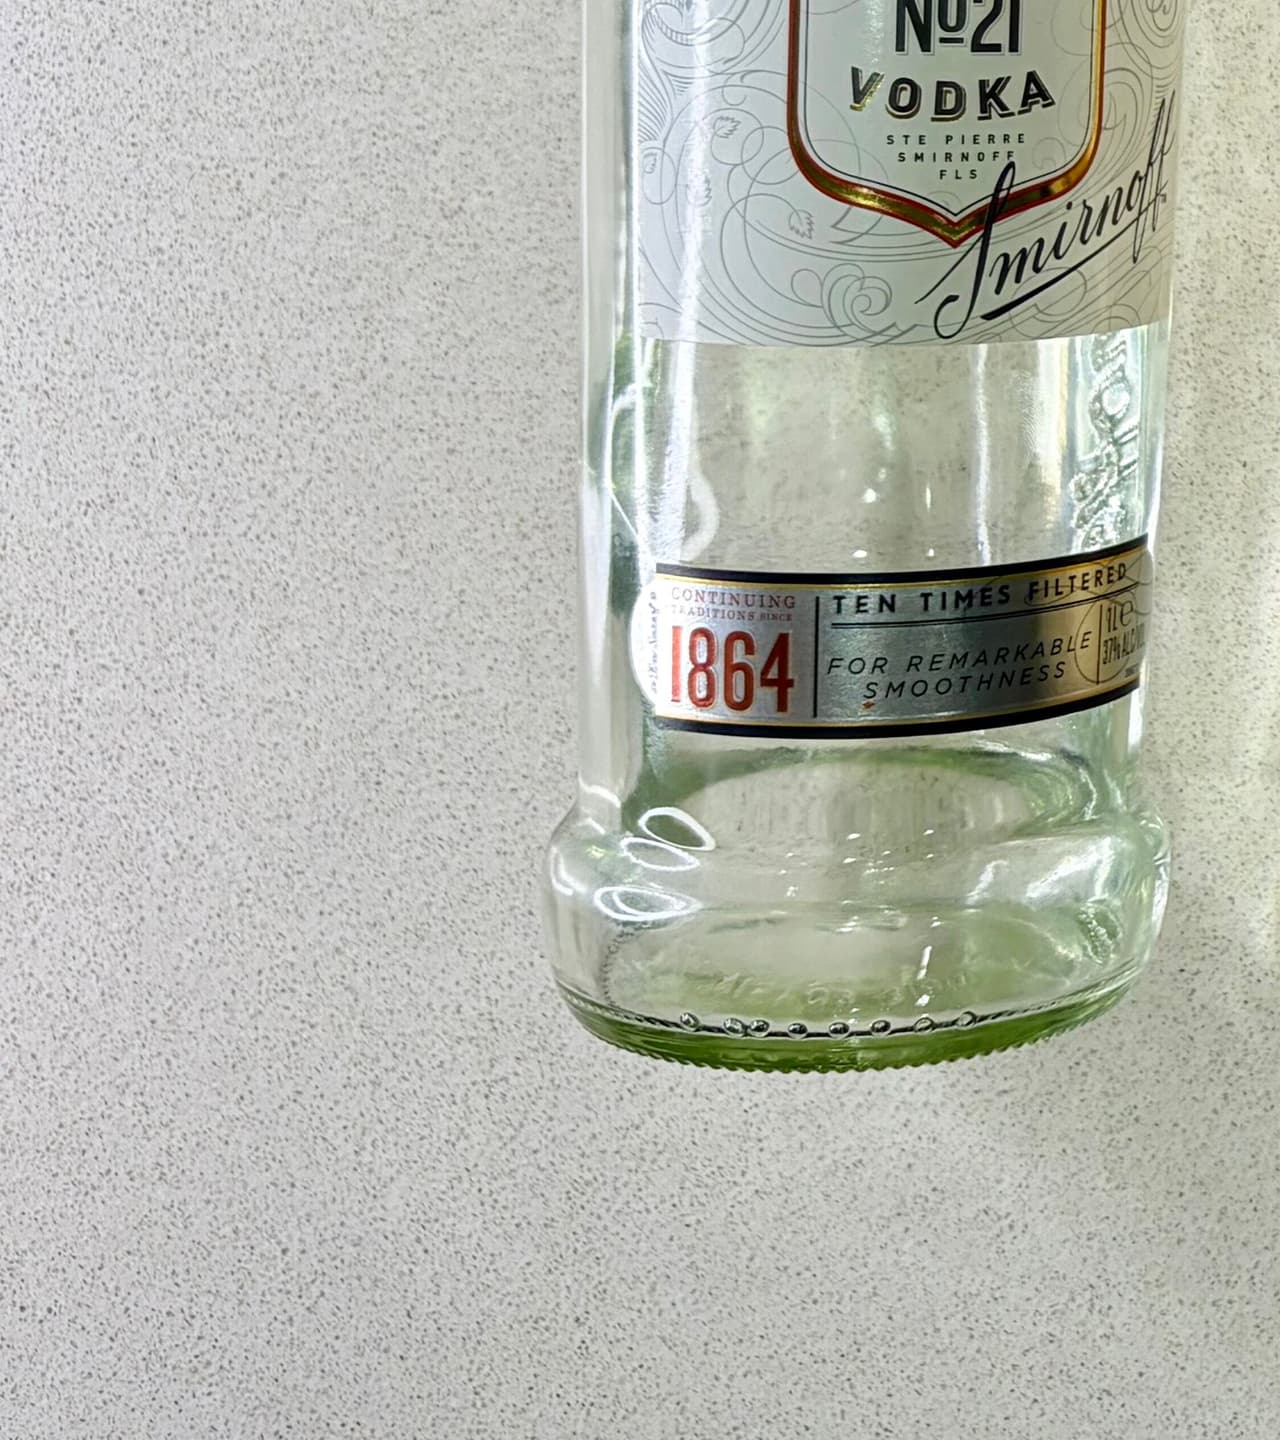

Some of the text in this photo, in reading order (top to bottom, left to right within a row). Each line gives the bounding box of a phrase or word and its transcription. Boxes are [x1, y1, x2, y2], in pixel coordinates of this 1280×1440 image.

[849, 66, 1056, 123] VODKA
[886, 133, 1026, 145] STE PIERRE
[897, 150, 1016, 163] SMIRNOFF
[938, 168, 979, 181] FLS
[914, 89, 1177, 340] Smirnoff
[671, 586, 796, 609] CONTINUING
[831, 562, 1128, 615] TEN TIMES FILTERED
[671, 604, 794, 622] TRADITIONS SINCE
[670, 625, 796, 714] 1864
[826, 657, 889, 676] FOR
[905, 630, 1093, 673] REMARKABLE
[862, 661, 1066, 700] SMOOTHNESS
